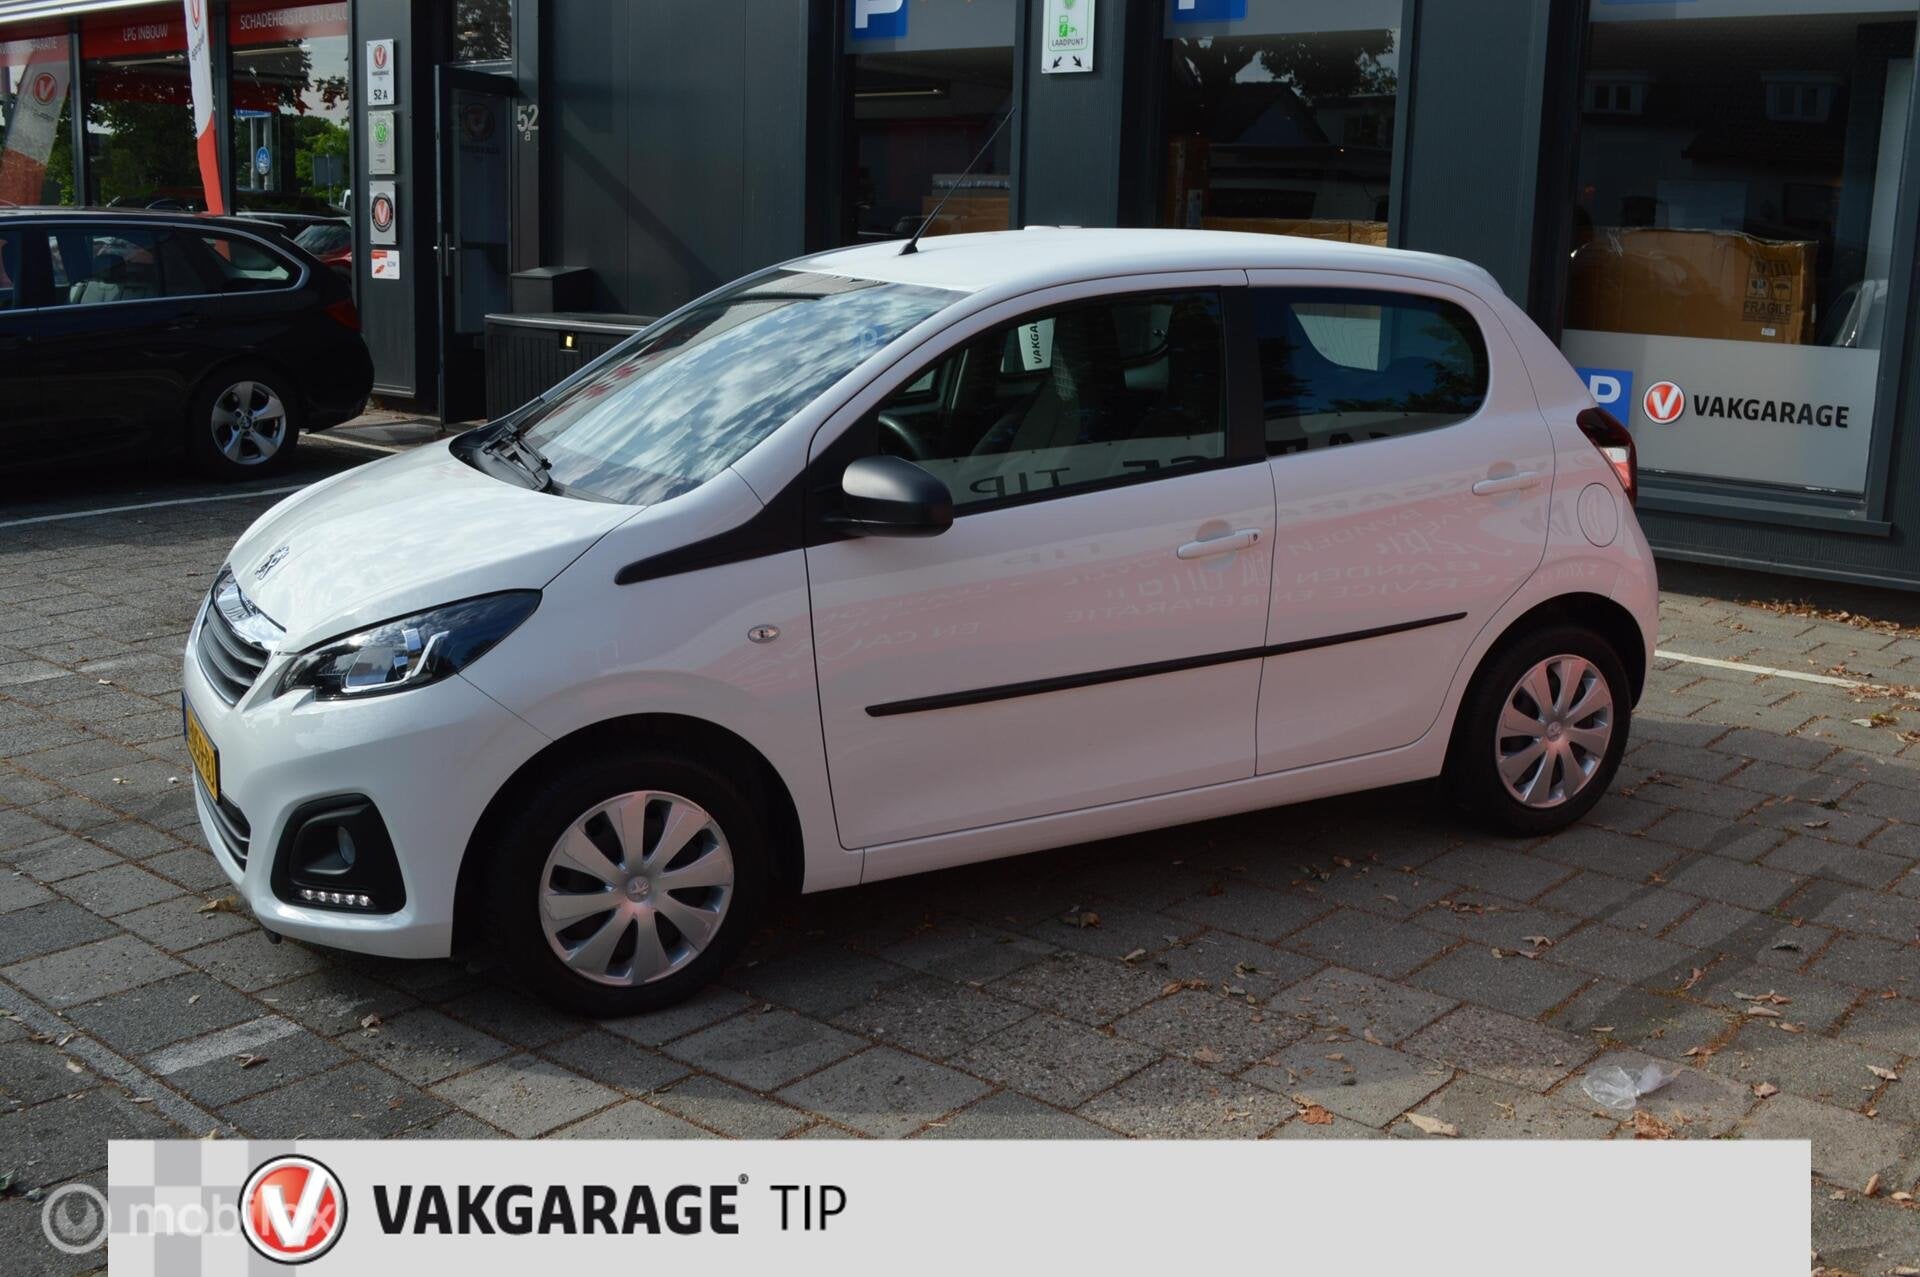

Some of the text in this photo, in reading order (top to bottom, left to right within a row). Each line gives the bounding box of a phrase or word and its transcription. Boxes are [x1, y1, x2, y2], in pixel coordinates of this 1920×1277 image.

[123, 24, 168, 42] LPG INBOUW
[1052, 38, 1084, 47] LAADPUNT
[373, 89, 388, 100] 52 A
[517, 104, 539, 132] 52
[524, 131, 531, 141] a
[1744, 300, 1791, 315] FRAGILE
[1693, 395, 1850, 428] VAKGARAGE
